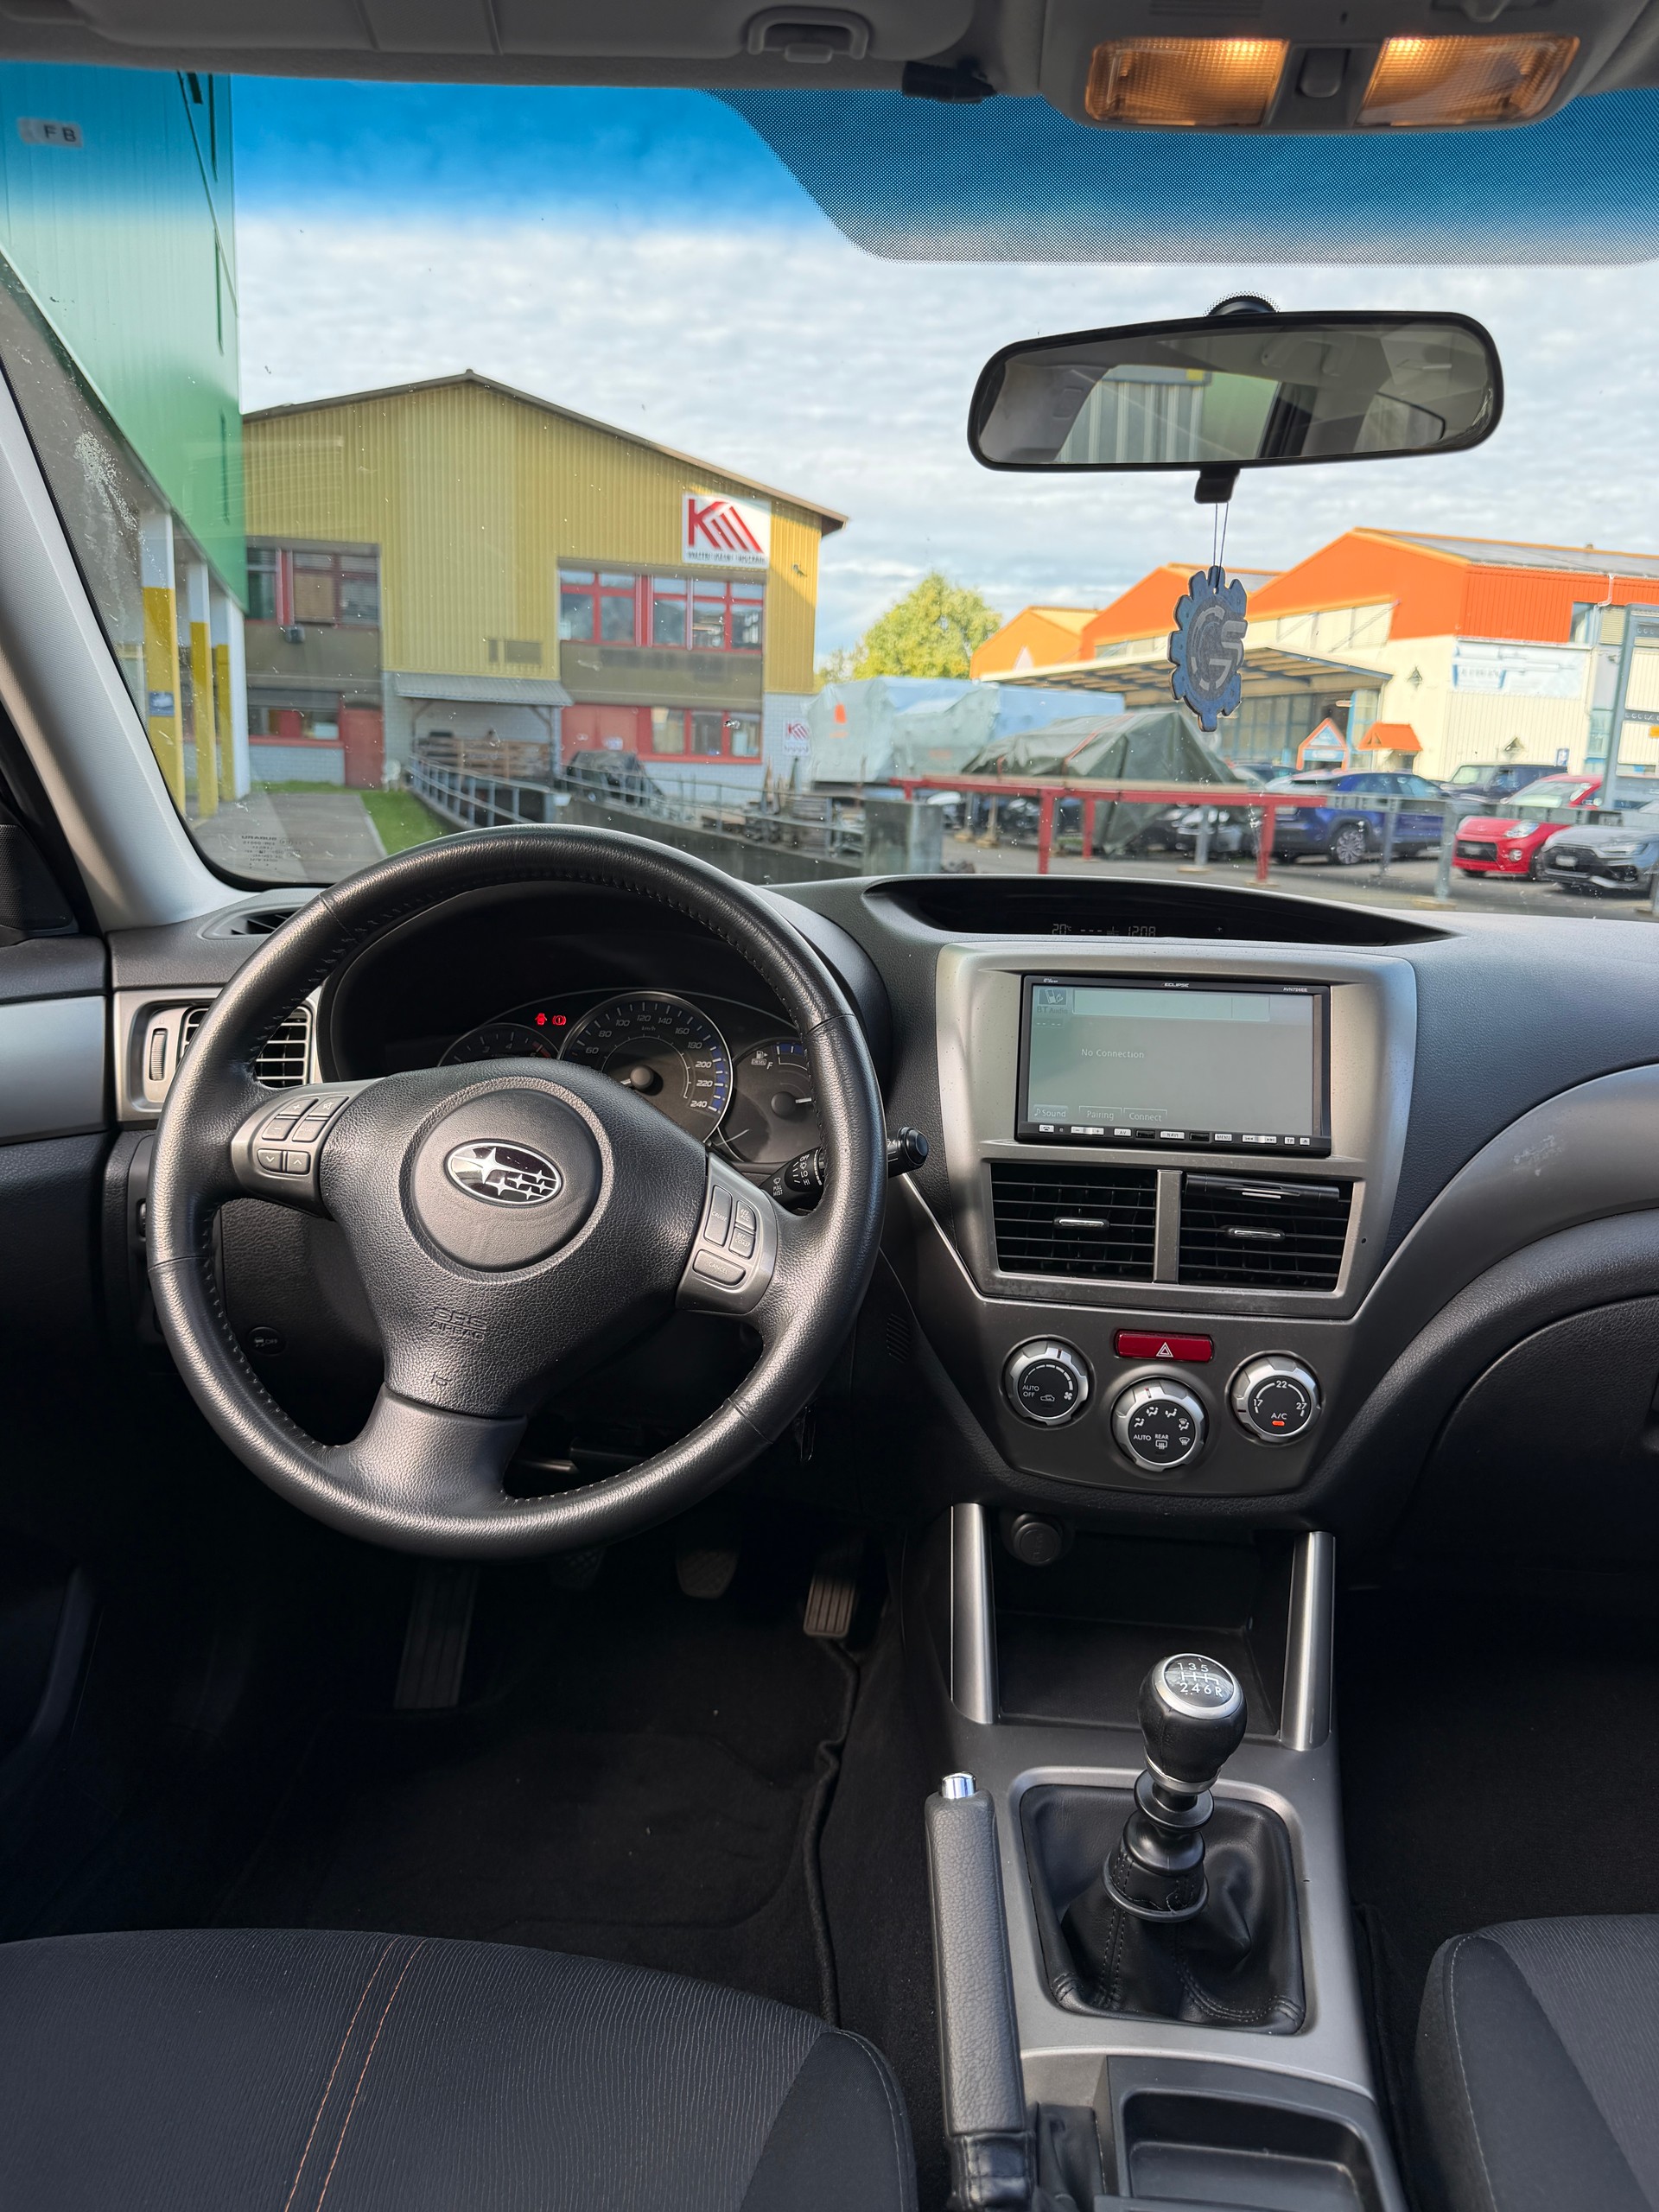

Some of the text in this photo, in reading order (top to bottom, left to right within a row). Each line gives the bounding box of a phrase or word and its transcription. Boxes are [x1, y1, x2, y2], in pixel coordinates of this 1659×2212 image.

[1081, 1048, 1145, 1059] No Connection
[766, 1061, 773, 1070] F
[1042, 1109, 1067, 1118] Sound
[1086, 1109, 1115, 1122] Pairing
[1128, 1111, 1162, 1122] Connect
[711, 1211, 728, 1222] CRUISE
[734, 1238, 751, 1248] COAST
[708, 1261, 728, 1274] CANCEL
[433, 1306, 487, 1331] SRS
[431, 1319, 485, 1341] AIRBAG
[1275, 1380, 1287, 1389] 22
[1253, 1398, 1263, 1407] 17
[1295, 1402, 1307, 1410] 27
[1188, 1662, 1198, 1671] 3
[1200, 1664, 1210, 1673] 5
[1179, 1682, 1224, 1698] 2 4 6 R
